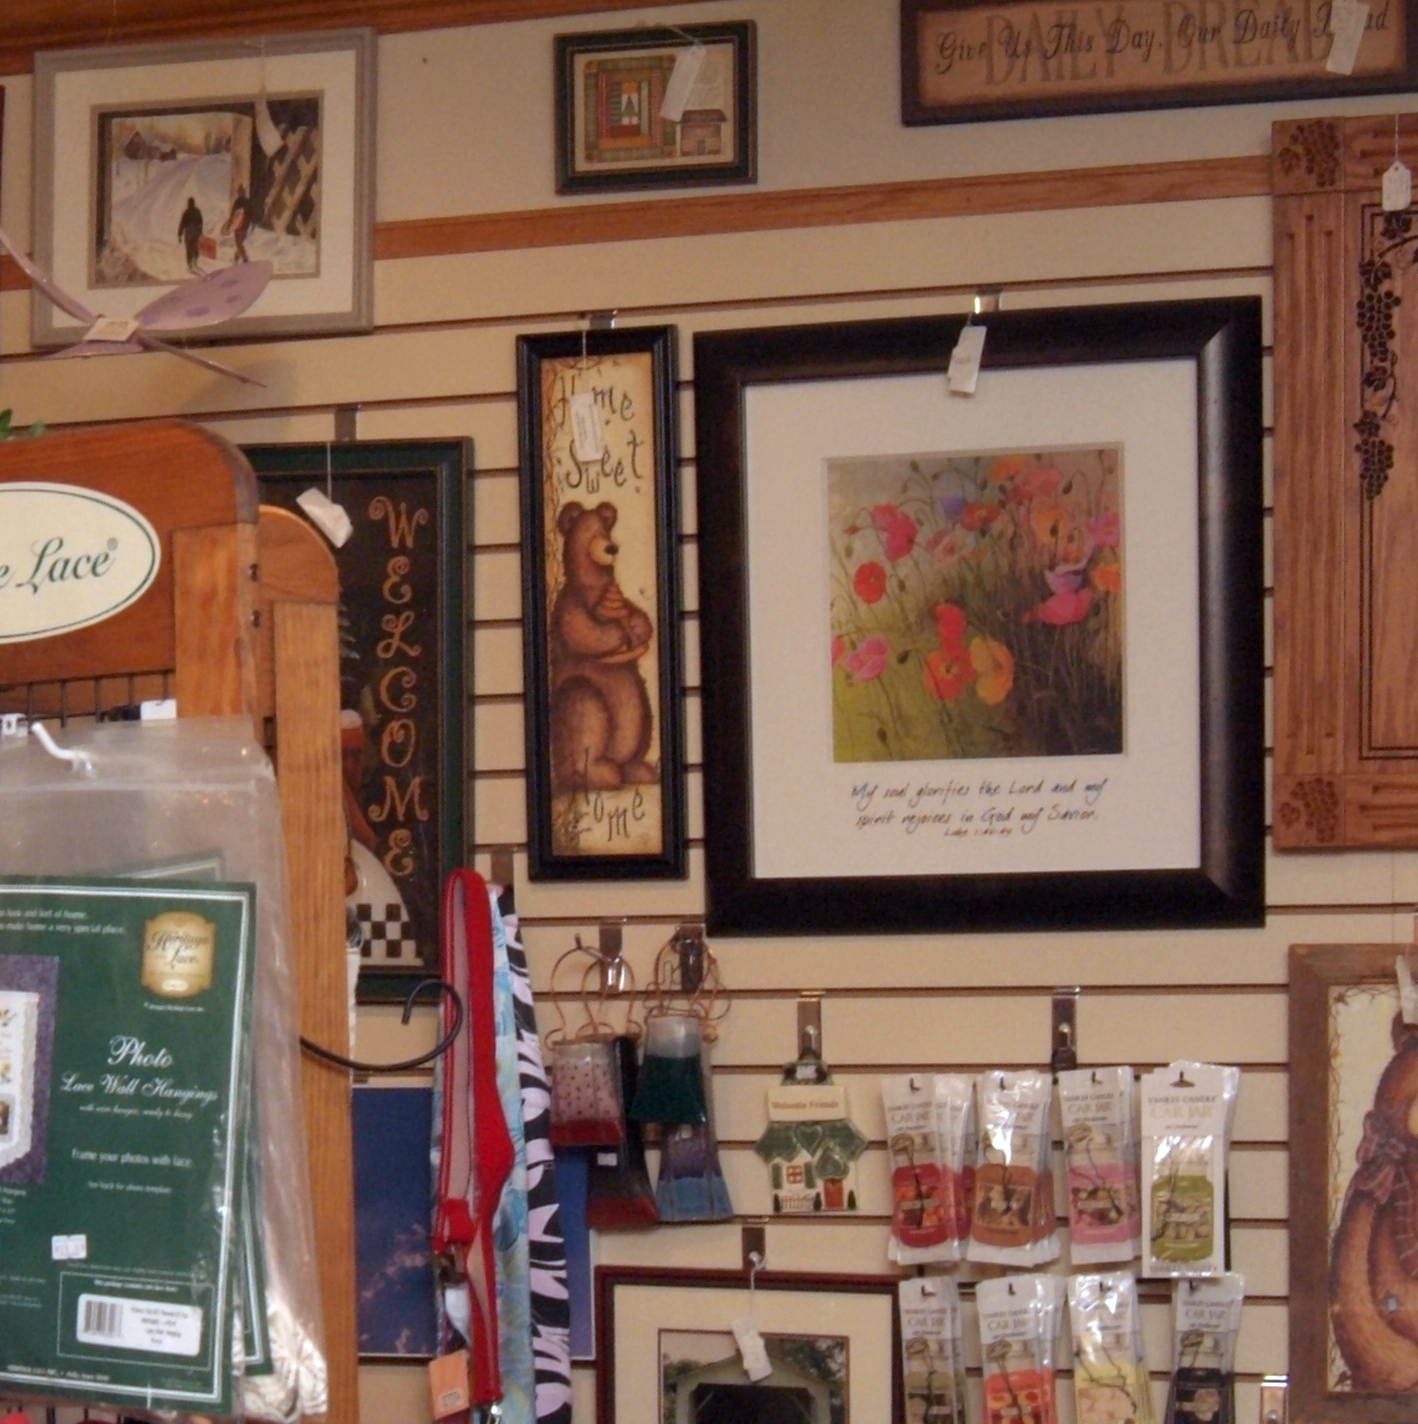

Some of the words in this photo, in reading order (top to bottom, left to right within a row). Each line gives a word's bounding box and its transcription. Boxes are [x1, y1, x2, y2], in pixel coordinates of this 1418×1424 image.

[935, 31, 989, 74] Give
[1043, 23, 1095, 58] This
[1232, 8, 1301, 51] Daily
[565, 430, 645, 495] Sweet
[15, 535, 114, 596] Lace
[368, 495, 429, 877] WELCOME
[1009, 779, 1043, 796] Lord
[981, 806, 1014, 825] God
[106, 1034, 175, 1069] Photo
[99, 1073, 141, 1096] Wall
